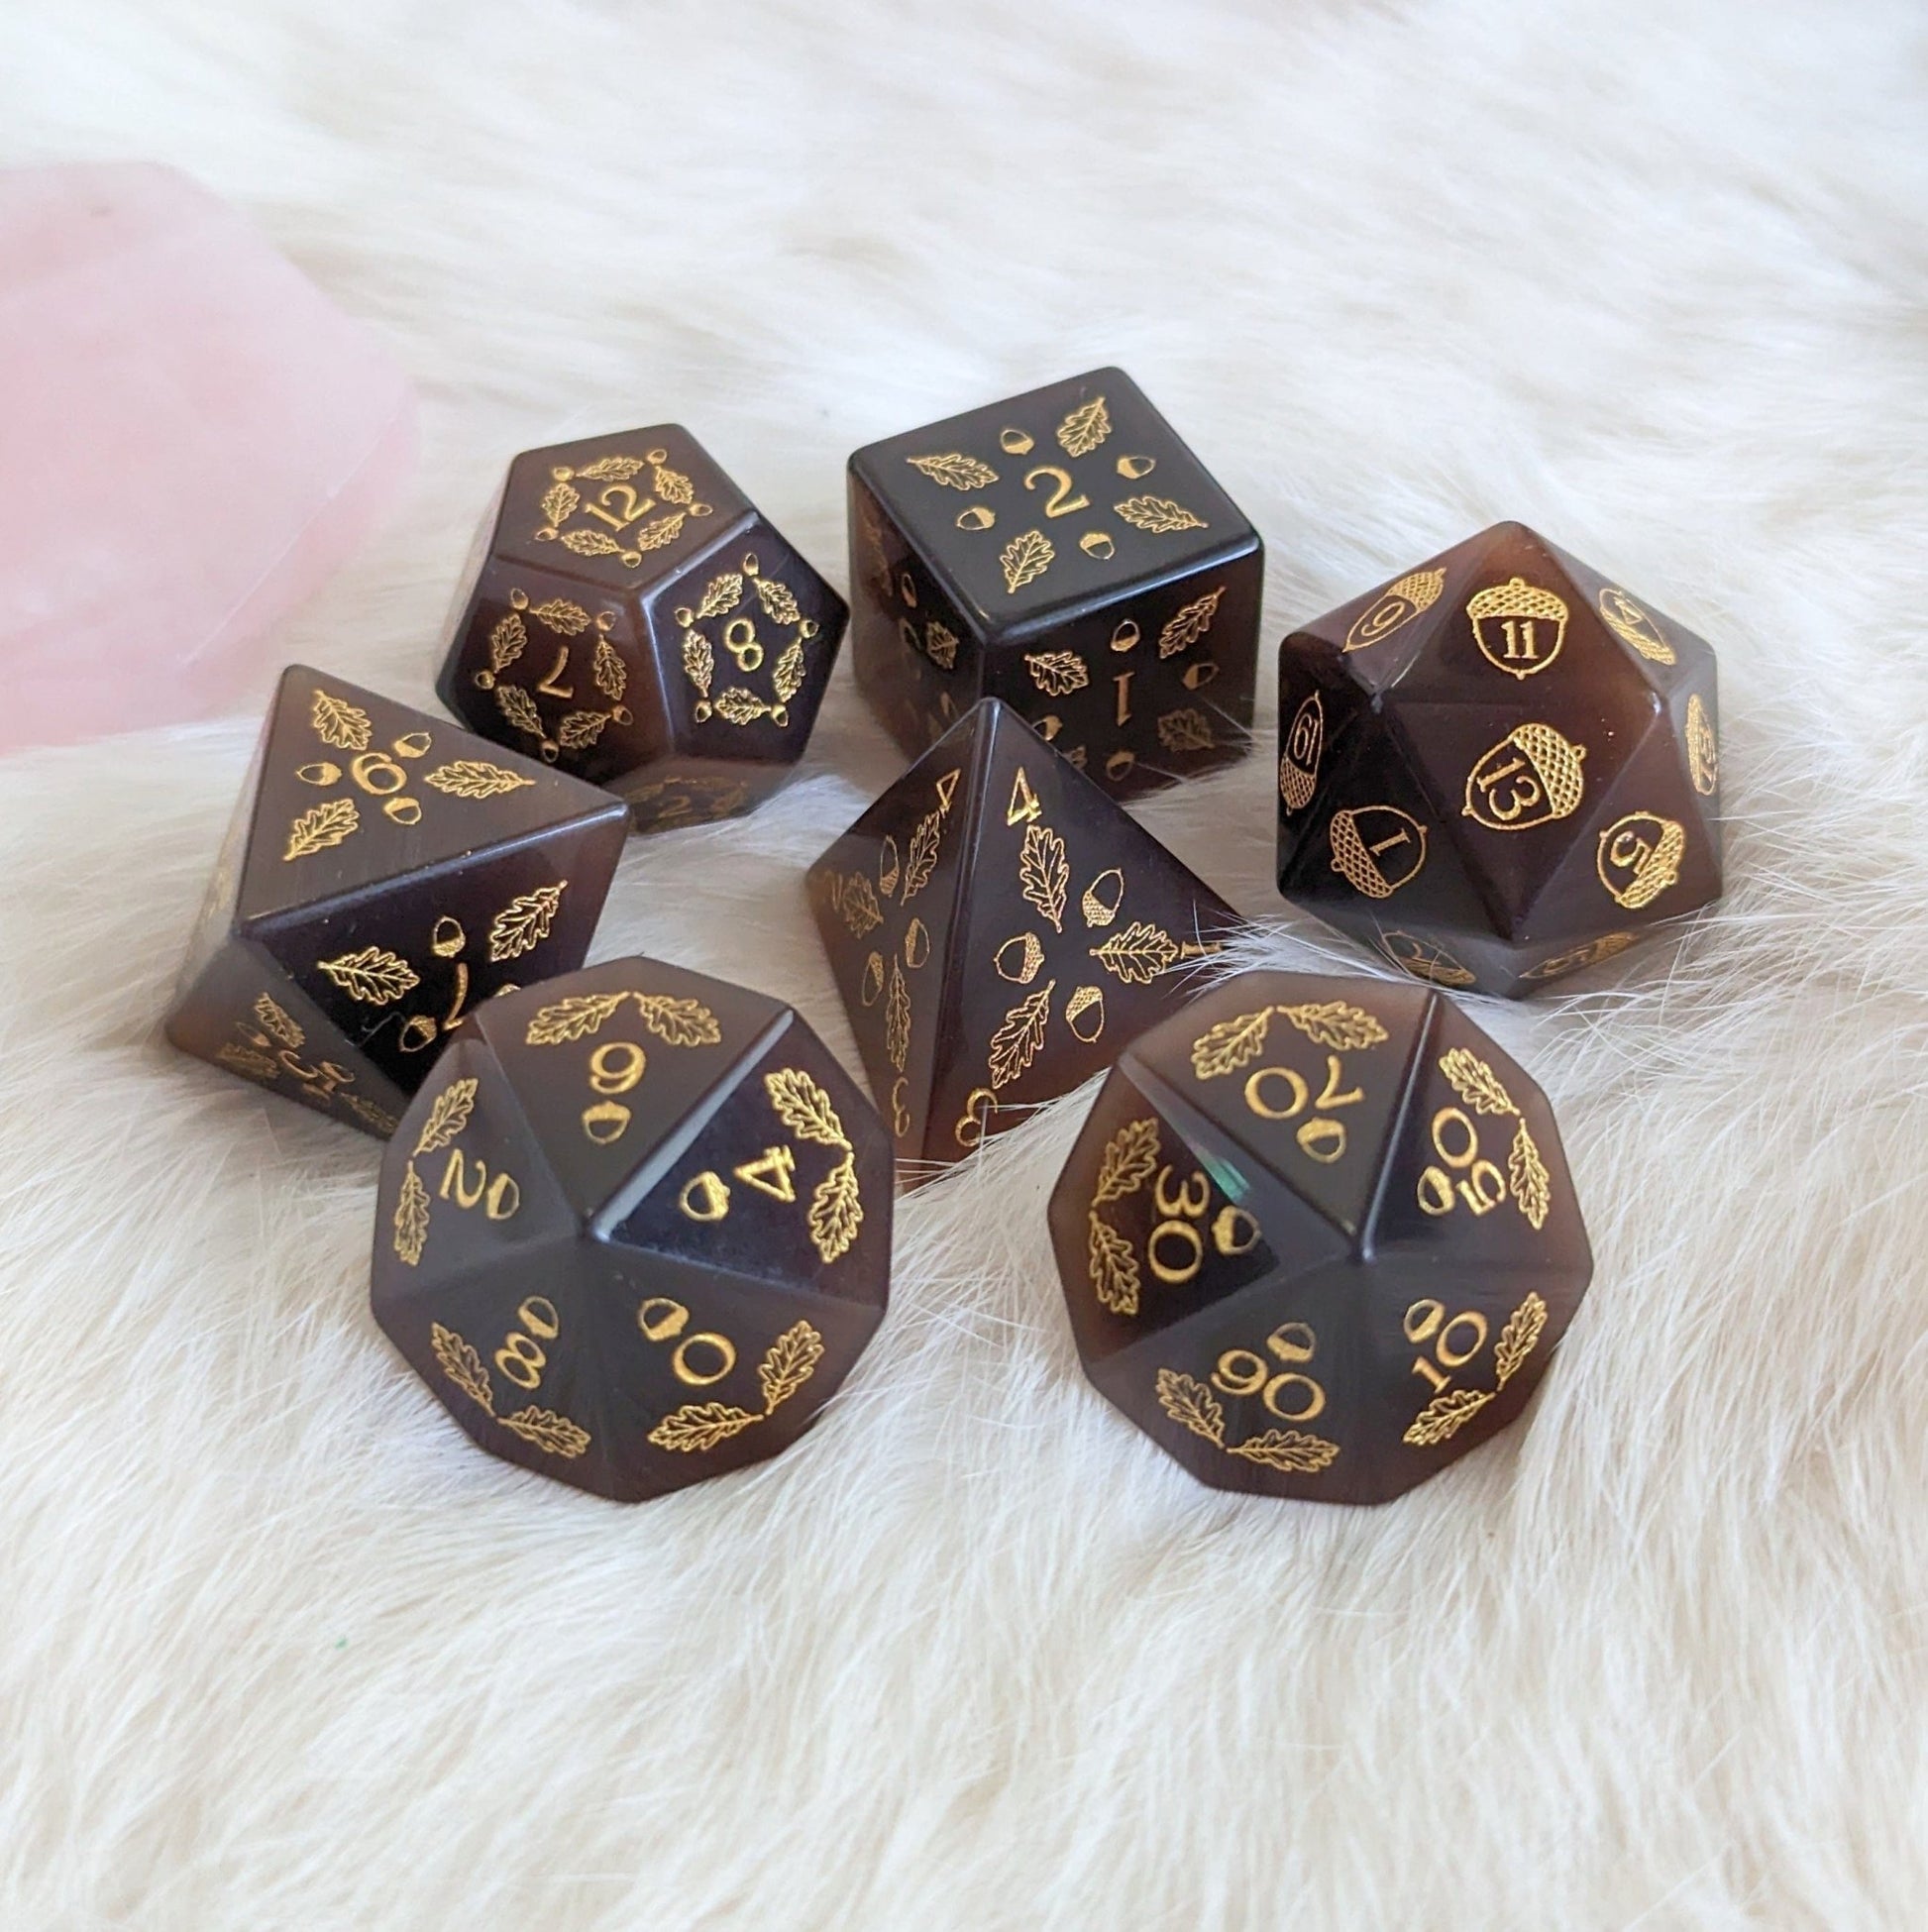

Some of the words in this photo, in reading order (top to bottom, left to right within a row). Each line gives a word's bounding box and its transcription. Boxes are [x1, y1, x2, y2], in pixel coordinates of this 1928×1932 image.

[585, 483, 657, 533] 12
[1024, 466, 1092, 519] 2
[723, 618, 766, 673] 8
[1360, 599, 1406, 637] 9
[1500, 620, 1539, 660] 11
[536, 644, 573, 699] 7
[1112, 670, 1136, 727] 1
[350, 751, 408, 796] 6
[1006, 767, 1041, 826] 4
[1476, 757, 1540, 820] 13
[1368, 827, 1413, 857] 1
[1610, 829, 1652, 874] 5
[1243, 1054, 1365, 1120] 70
[439, 1147, 488, 1210] 2
[732, 1143, 798, 1204] 4
[1431, 1106, 1506, 1218] 50
[1147, 1163, 1211, 1284] 30
[495, 1331, 547, 1390] 8
[671, 1332, 738, 1386] 0
[1411, 1310, 1488, 1395] 10
[1210, 1348, 1327, 1422] 90
